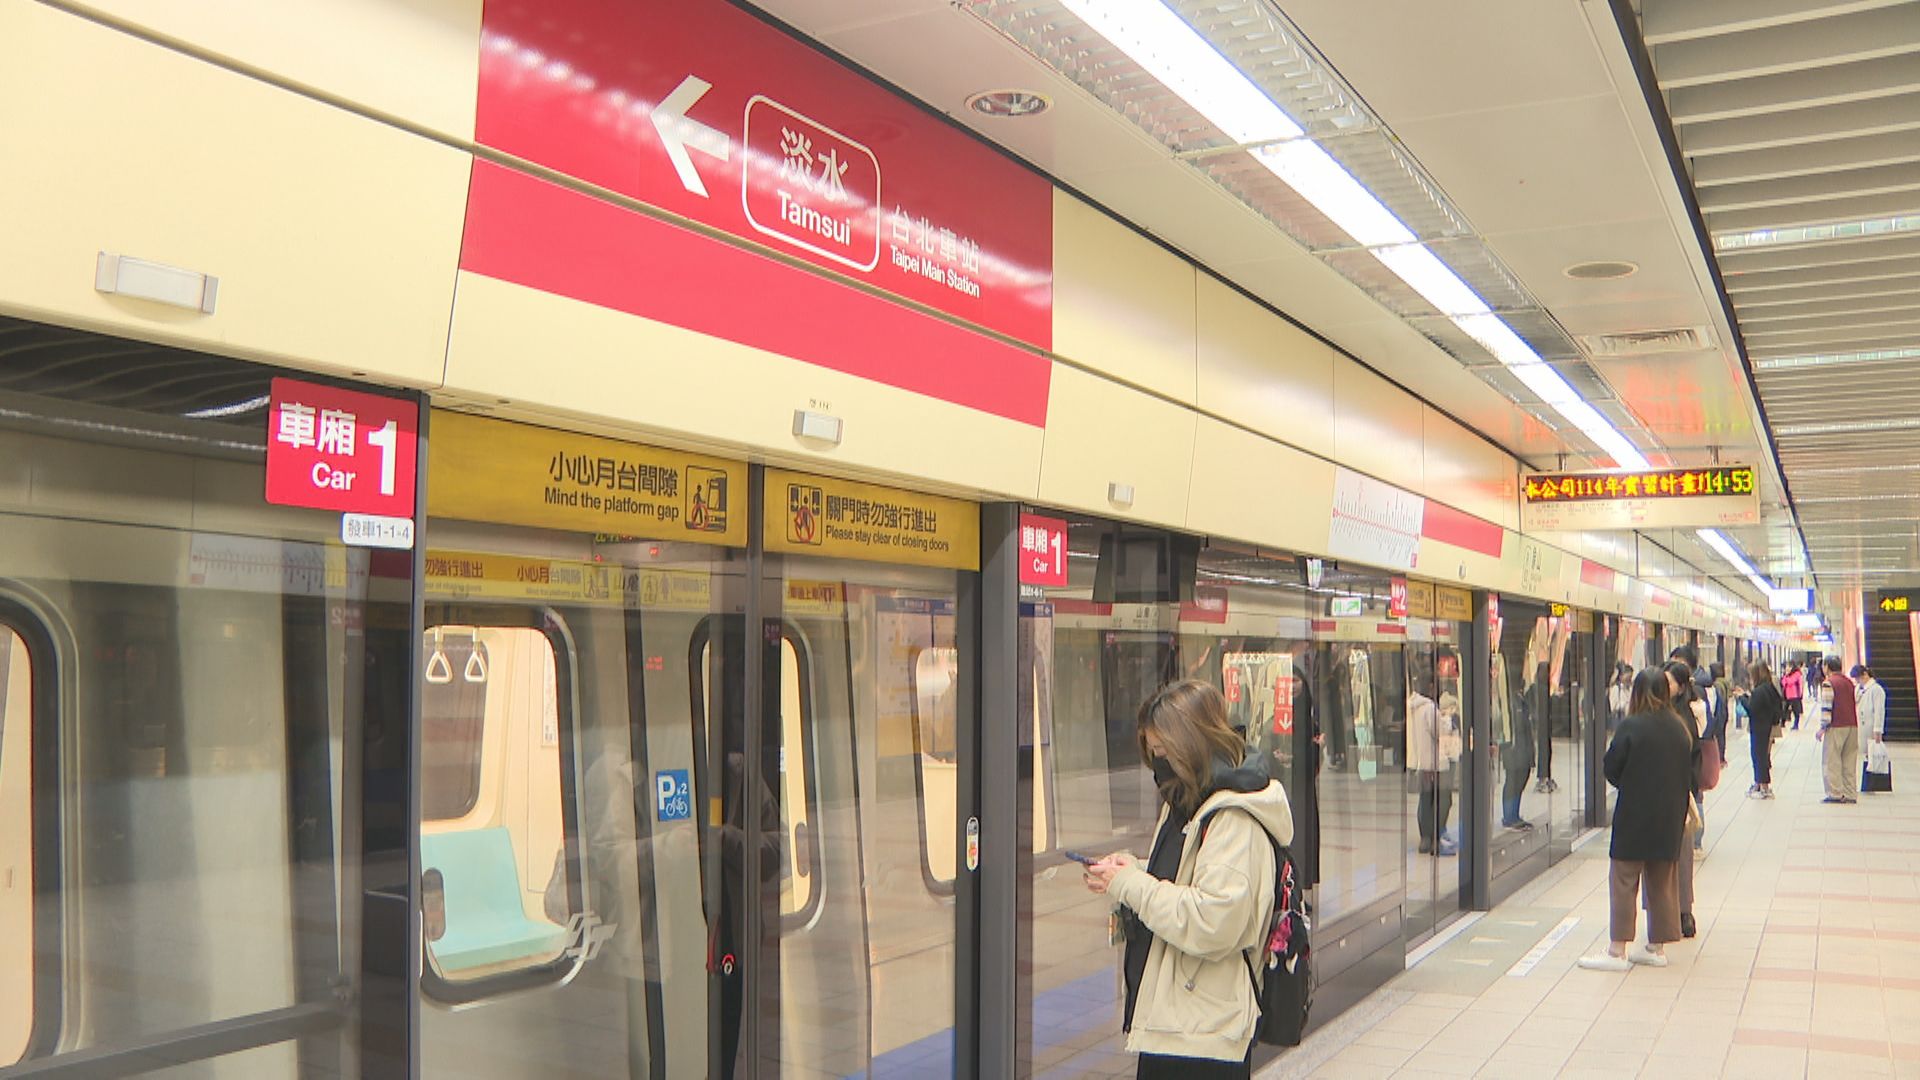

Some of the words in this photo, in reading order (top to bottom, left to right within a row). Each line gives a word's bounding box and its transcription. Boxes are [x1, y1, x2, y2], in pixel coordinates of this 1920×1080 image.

[780, 125, 849, 202] 淡水
[777, 188, 850, 246] Tamsui
[892, 203, 979, 275] 台北車站
[890, 244, 920, 274] Taipei
[921, 256, 946, 285] Main
[946, 268, 981, 299] Station
[276, 401, 357, 457] 車廂
[367, 419, 398, 497] 1
[312, 461, 357, 491] Car
[549, 450, 679, 498] 小心月台間隙
[1705, 469, 1754, 494] 14:53
[544, 485, 578, 506] Mind
[580, 490, 601, 510] the
[603, 494, 655, 515] platform
[656, 503, 679, 522] gap
[825, 494, 937, 534] 關門時勿強行進出
[825, 524, 854, 541] Please
[855, 528, 872, 546] stay
[872, 529, 891, 546] clear
[892, 532, 901, 546] of
[901, 532, 928, 553] closing
[928, 536, 949, 552] doors
[1050, 530, 1061, 575] 1
[1033, 558, 1048, 574] Car
[657, 774, 676, 811] P
[680, 782, 688, 795] 2
